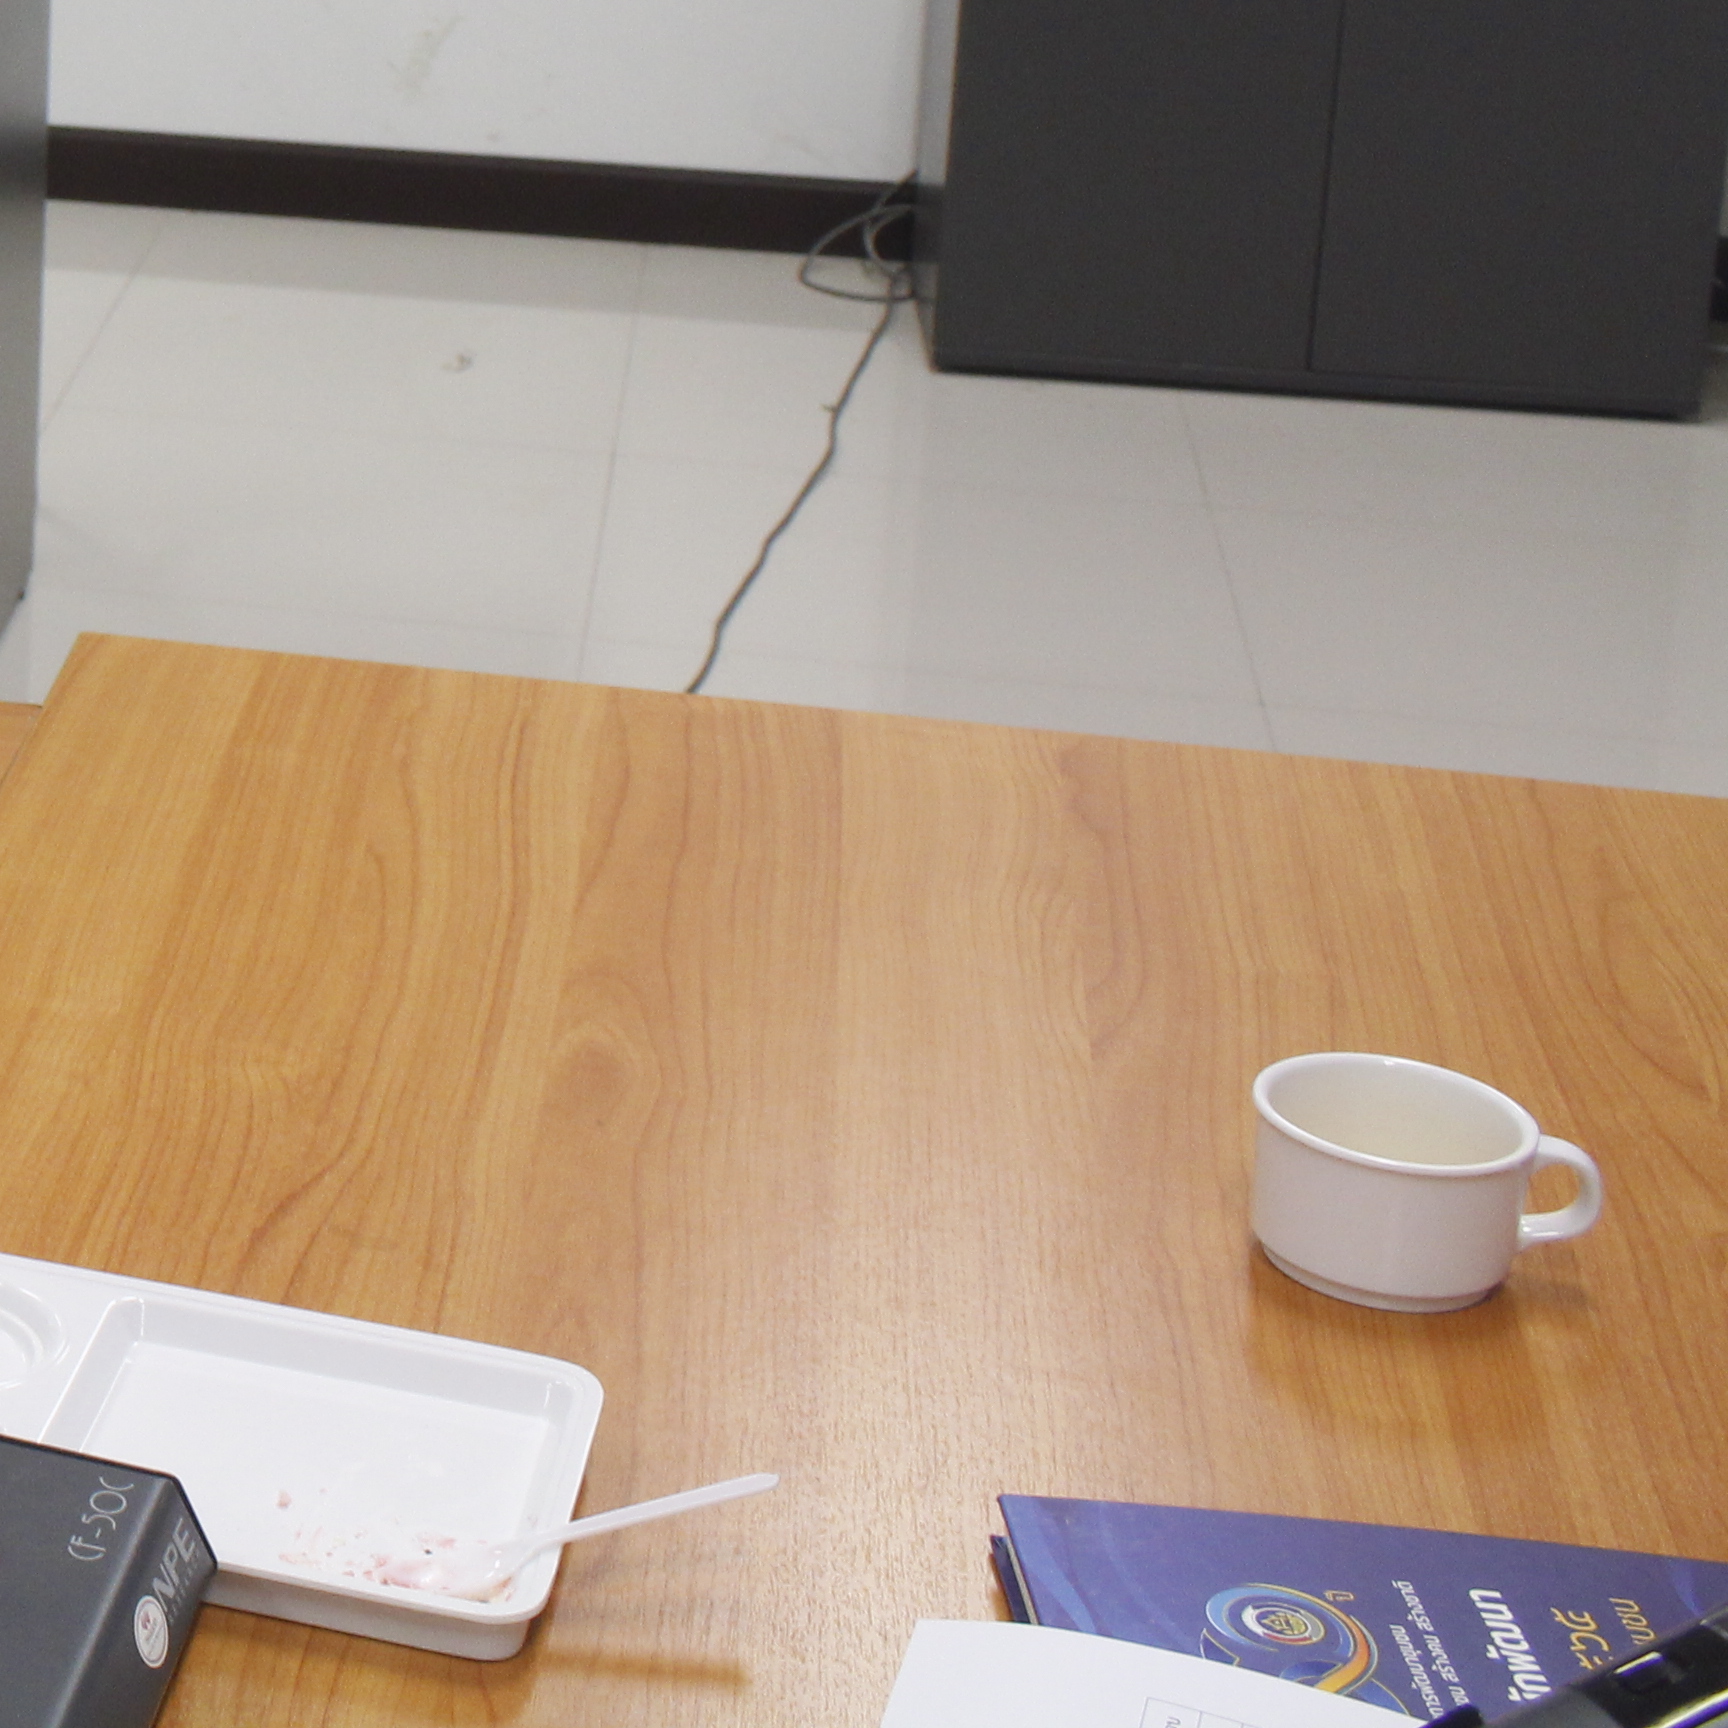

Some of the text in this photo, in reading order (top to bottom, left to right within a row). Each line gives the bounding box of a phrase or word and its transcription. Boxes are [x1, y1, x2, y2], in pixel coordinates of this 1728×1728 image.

[151, 1518, 198, 1614] NPE
[1388, 1624, 1444, 1718] การพัฒนาชุมชน
